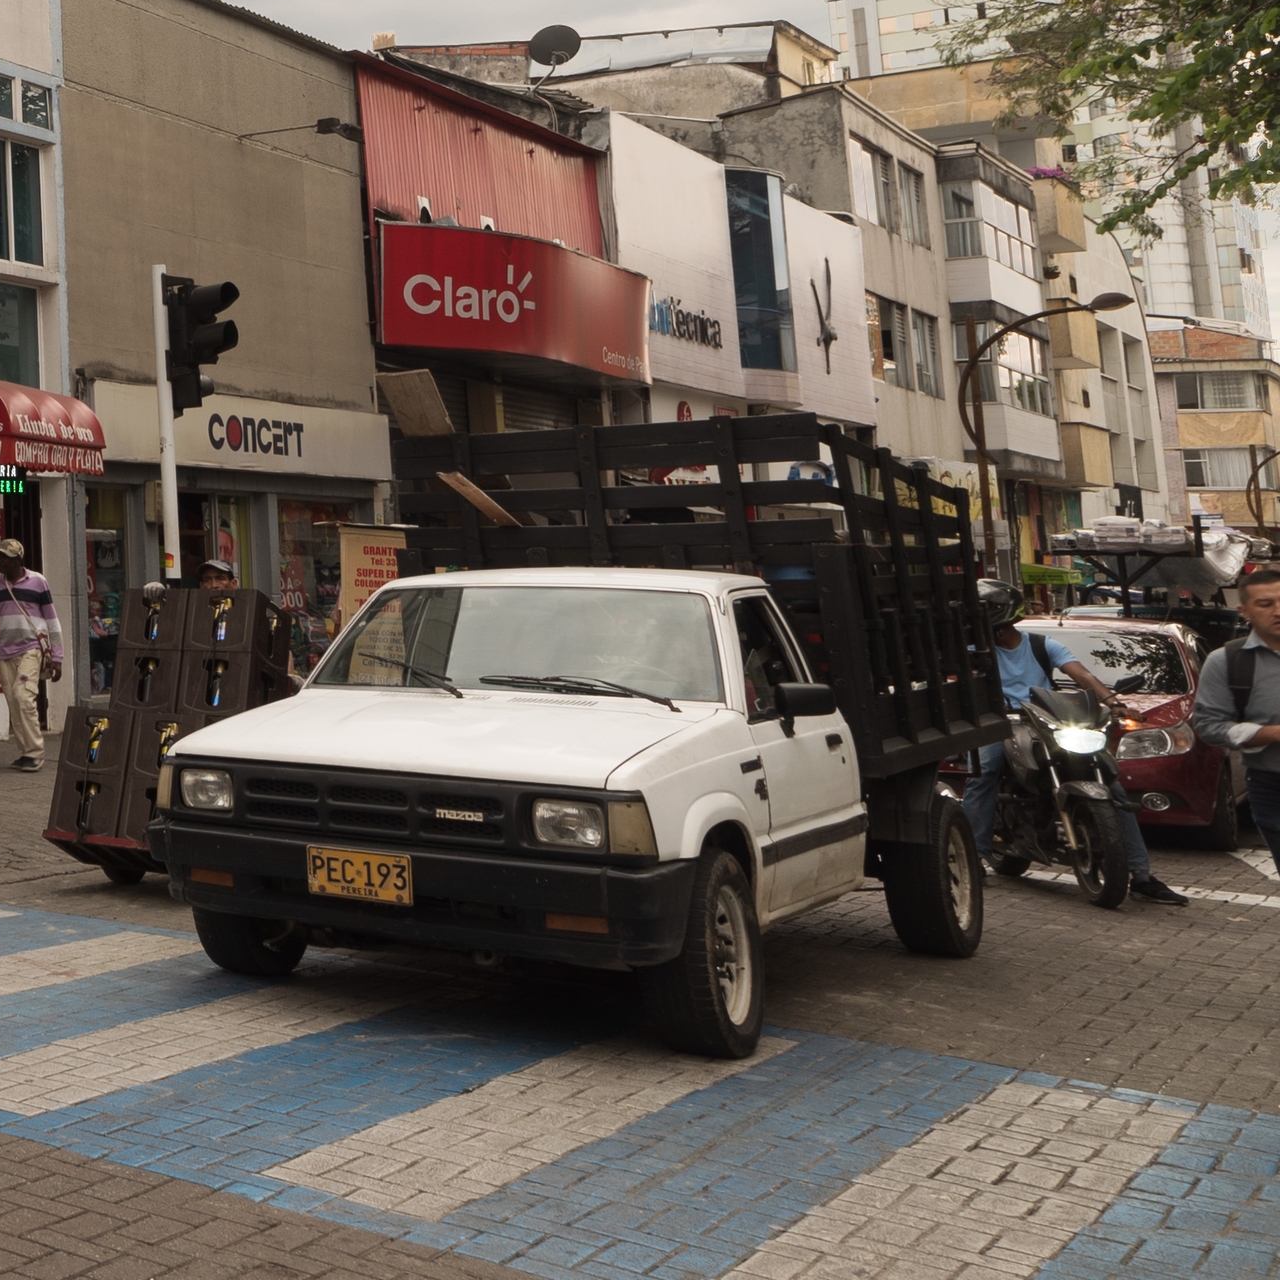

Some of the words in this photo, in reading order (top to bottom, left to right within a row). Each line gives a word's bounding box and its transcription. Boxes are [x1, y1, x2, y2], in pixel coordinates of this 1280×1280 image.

[403, 273, 520, 323] Claro
[602, 346, 626, 368] Centro
[627, 354, 635, 371] de
[15, 413, 56, 440] Lluvia
[58, 419, 75, 441] de
[76, 426, 95, 443] oro
[15, 441, 48, 465] COMPRO
[51, 445, 67, 466] ORO
[67, 446, 74, 465] Y
[76, 447, 104, 471] PLATA
[356, 568, 384, 578] SUPER
[371, 557, 385, 566] Tel:
[386, 558, 397, 567] 33
[435, 807, 483, 822] mazda
[312, 855, 355, 884] PEC
[363, 861, 407, 891] 193
[341, 886, 379, 897] PEREIRA
